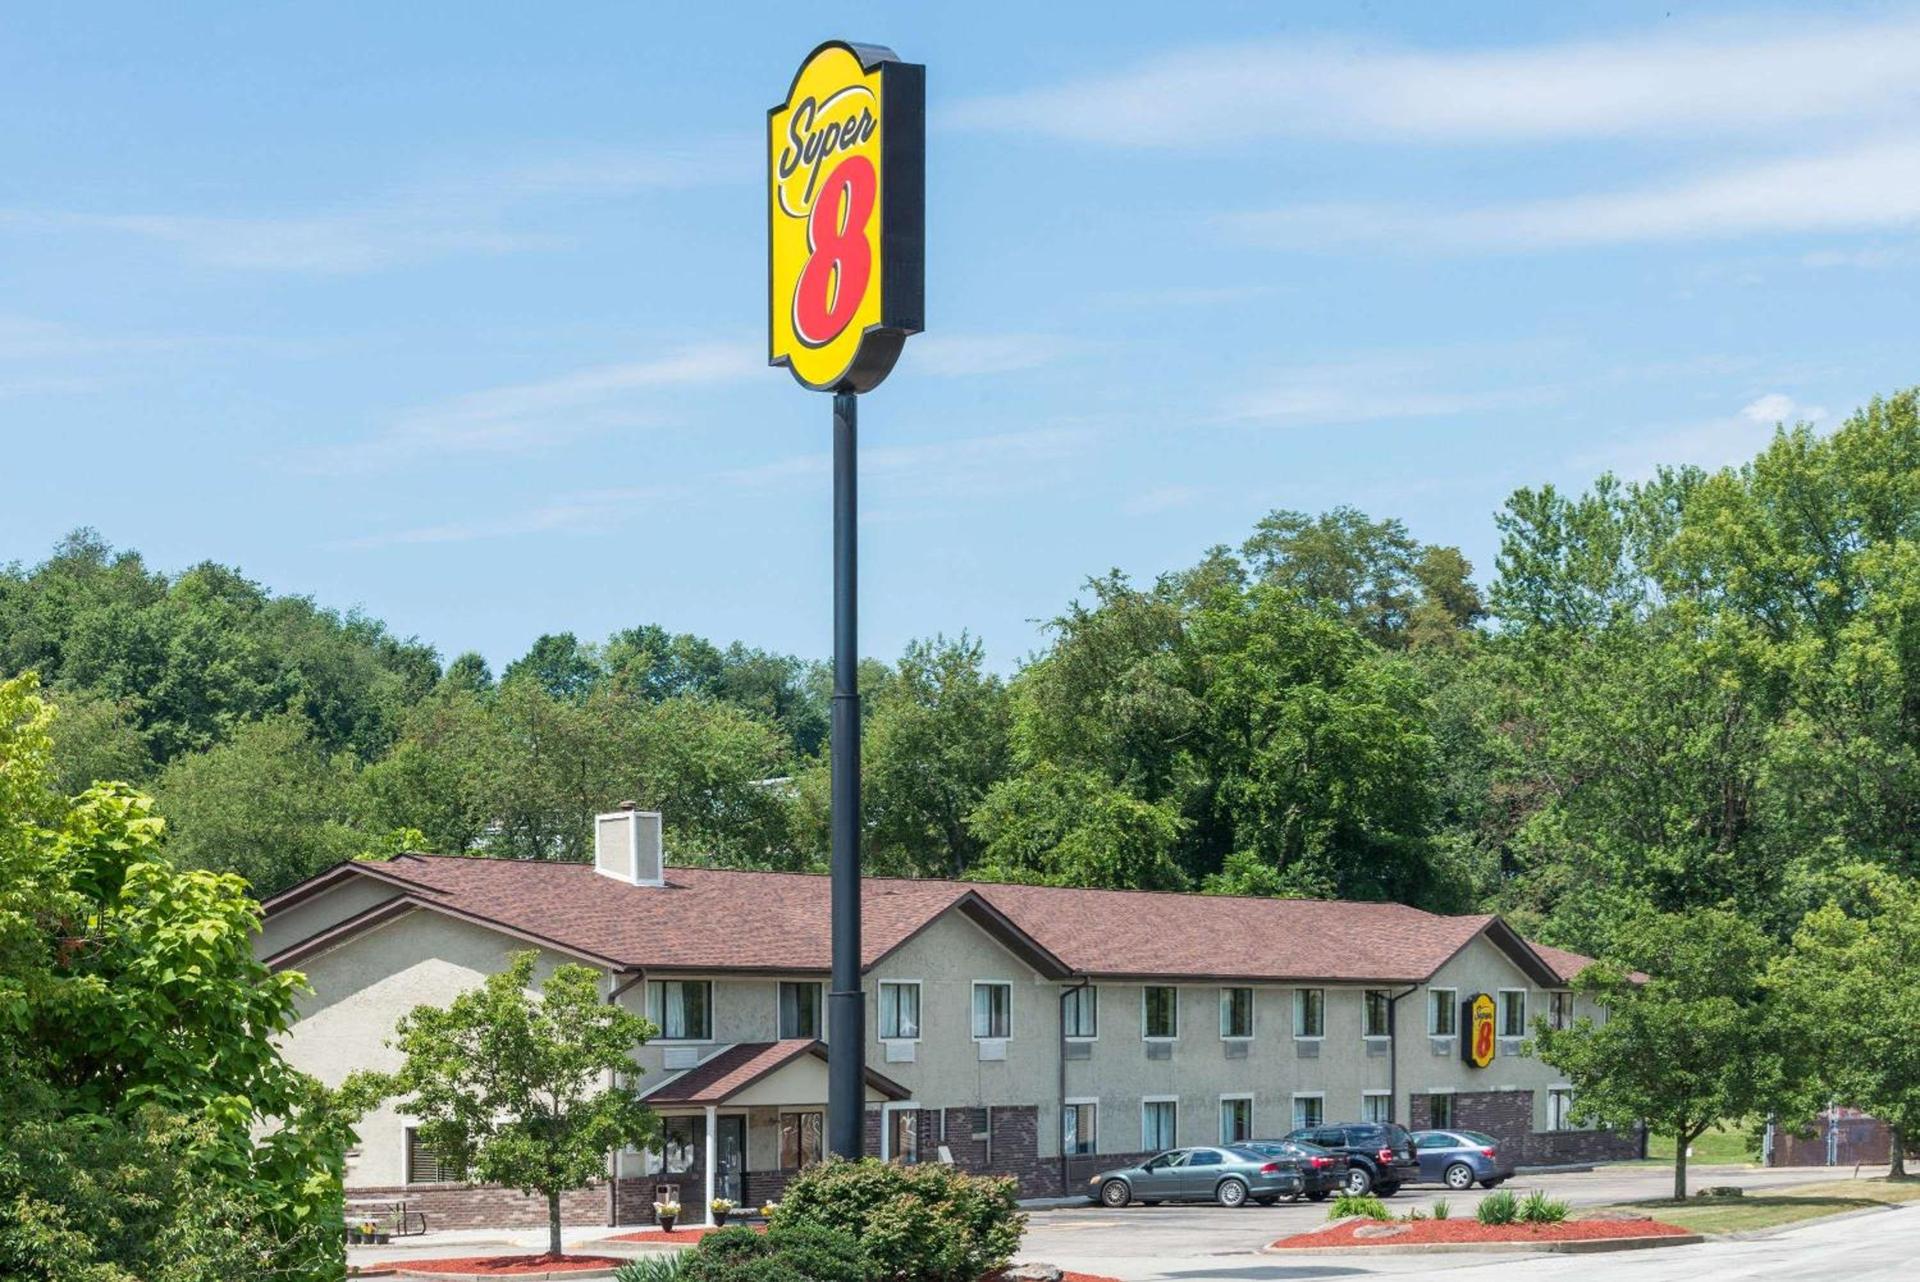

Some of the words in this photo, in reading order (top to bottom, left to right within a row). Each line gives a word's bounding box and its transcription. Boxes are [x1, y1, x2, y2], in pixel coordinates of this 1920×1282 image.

[778, 96, 877, 204] Super
[792, 155, 877, 349] 8
[1477, 1021, 1492, 1058] 8
